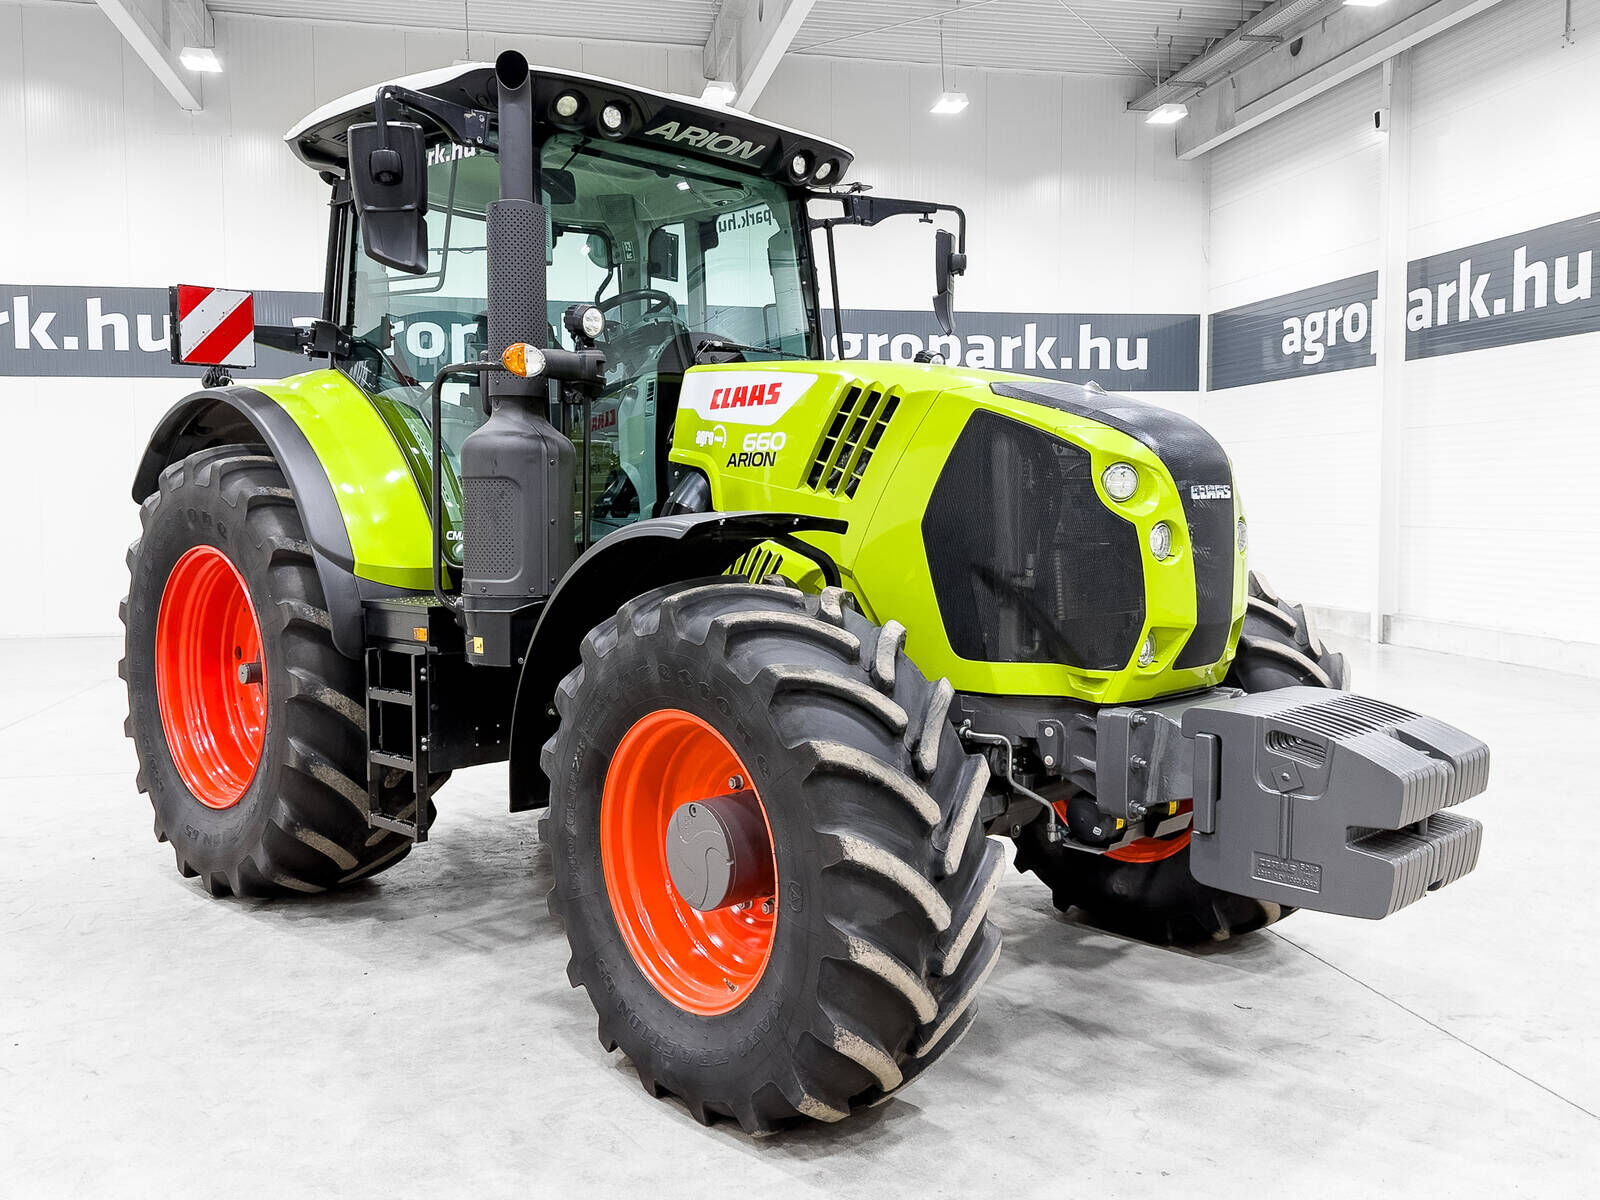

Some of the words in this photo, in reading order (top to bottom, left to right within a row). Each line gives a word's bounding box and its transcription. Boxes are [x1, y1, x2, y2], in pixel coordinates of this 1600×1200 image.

[645, 121, 766, 160] ARION
[822, 322, 1148, 370] gropark.hu
[709, 382, 783, 411] CLAAS
[742, 432, 787, 451] 660
[726, 451, 777, 468] ARION
[1190, 484, 1232, 500] CLAAS
